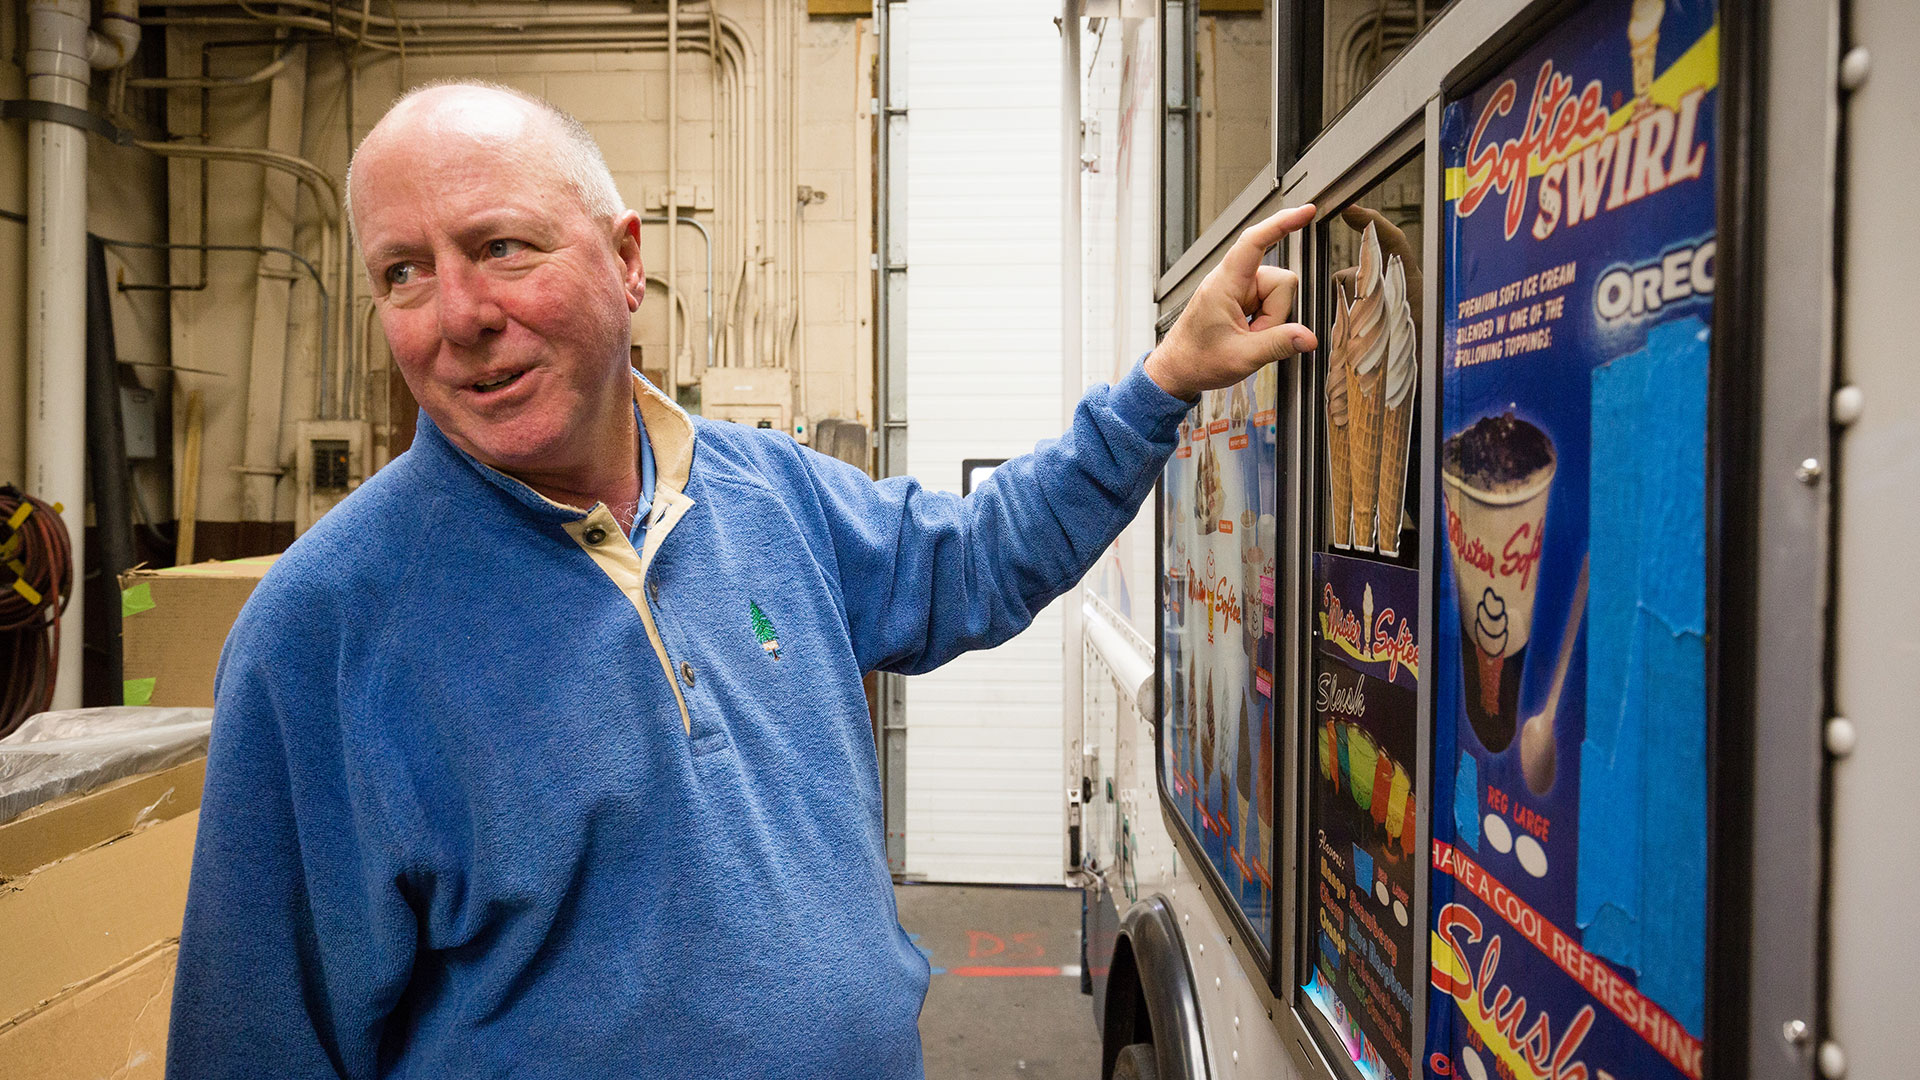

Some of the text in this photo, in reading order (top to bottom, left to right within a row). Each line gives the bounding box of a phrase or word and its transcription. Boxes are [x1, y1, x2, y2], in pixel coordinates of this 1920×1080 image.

[1456, 60, 1610, 241] Softee
[1532, 85, 1707, 241] SWIRL
[1458, 261, 1577, 319] PREMIUM SOFT ICE CREAM
[1456, 318, 1495, 345] BLENDED
[1508, 307, 1529, 332] ONE
[1529, 302, 1543, 326] OF
[1544, 295, 1566, 321] THE
[1454, 340, 1503, 368] FOLLOWING
[1323, 582, 1361, 650] Mister
[1316, 672, 1366, 718] Slush
[1486, 784, 1551, 843] REG LARGE
[1432, 842, 1475, 889] HAVE
[1478, 873, 1491, 902] A
[1493, 887, 1549, 950] COOL
[1320, 906, 1346, 956] Orange
[1430, 902, 1596, 1080] Slush
